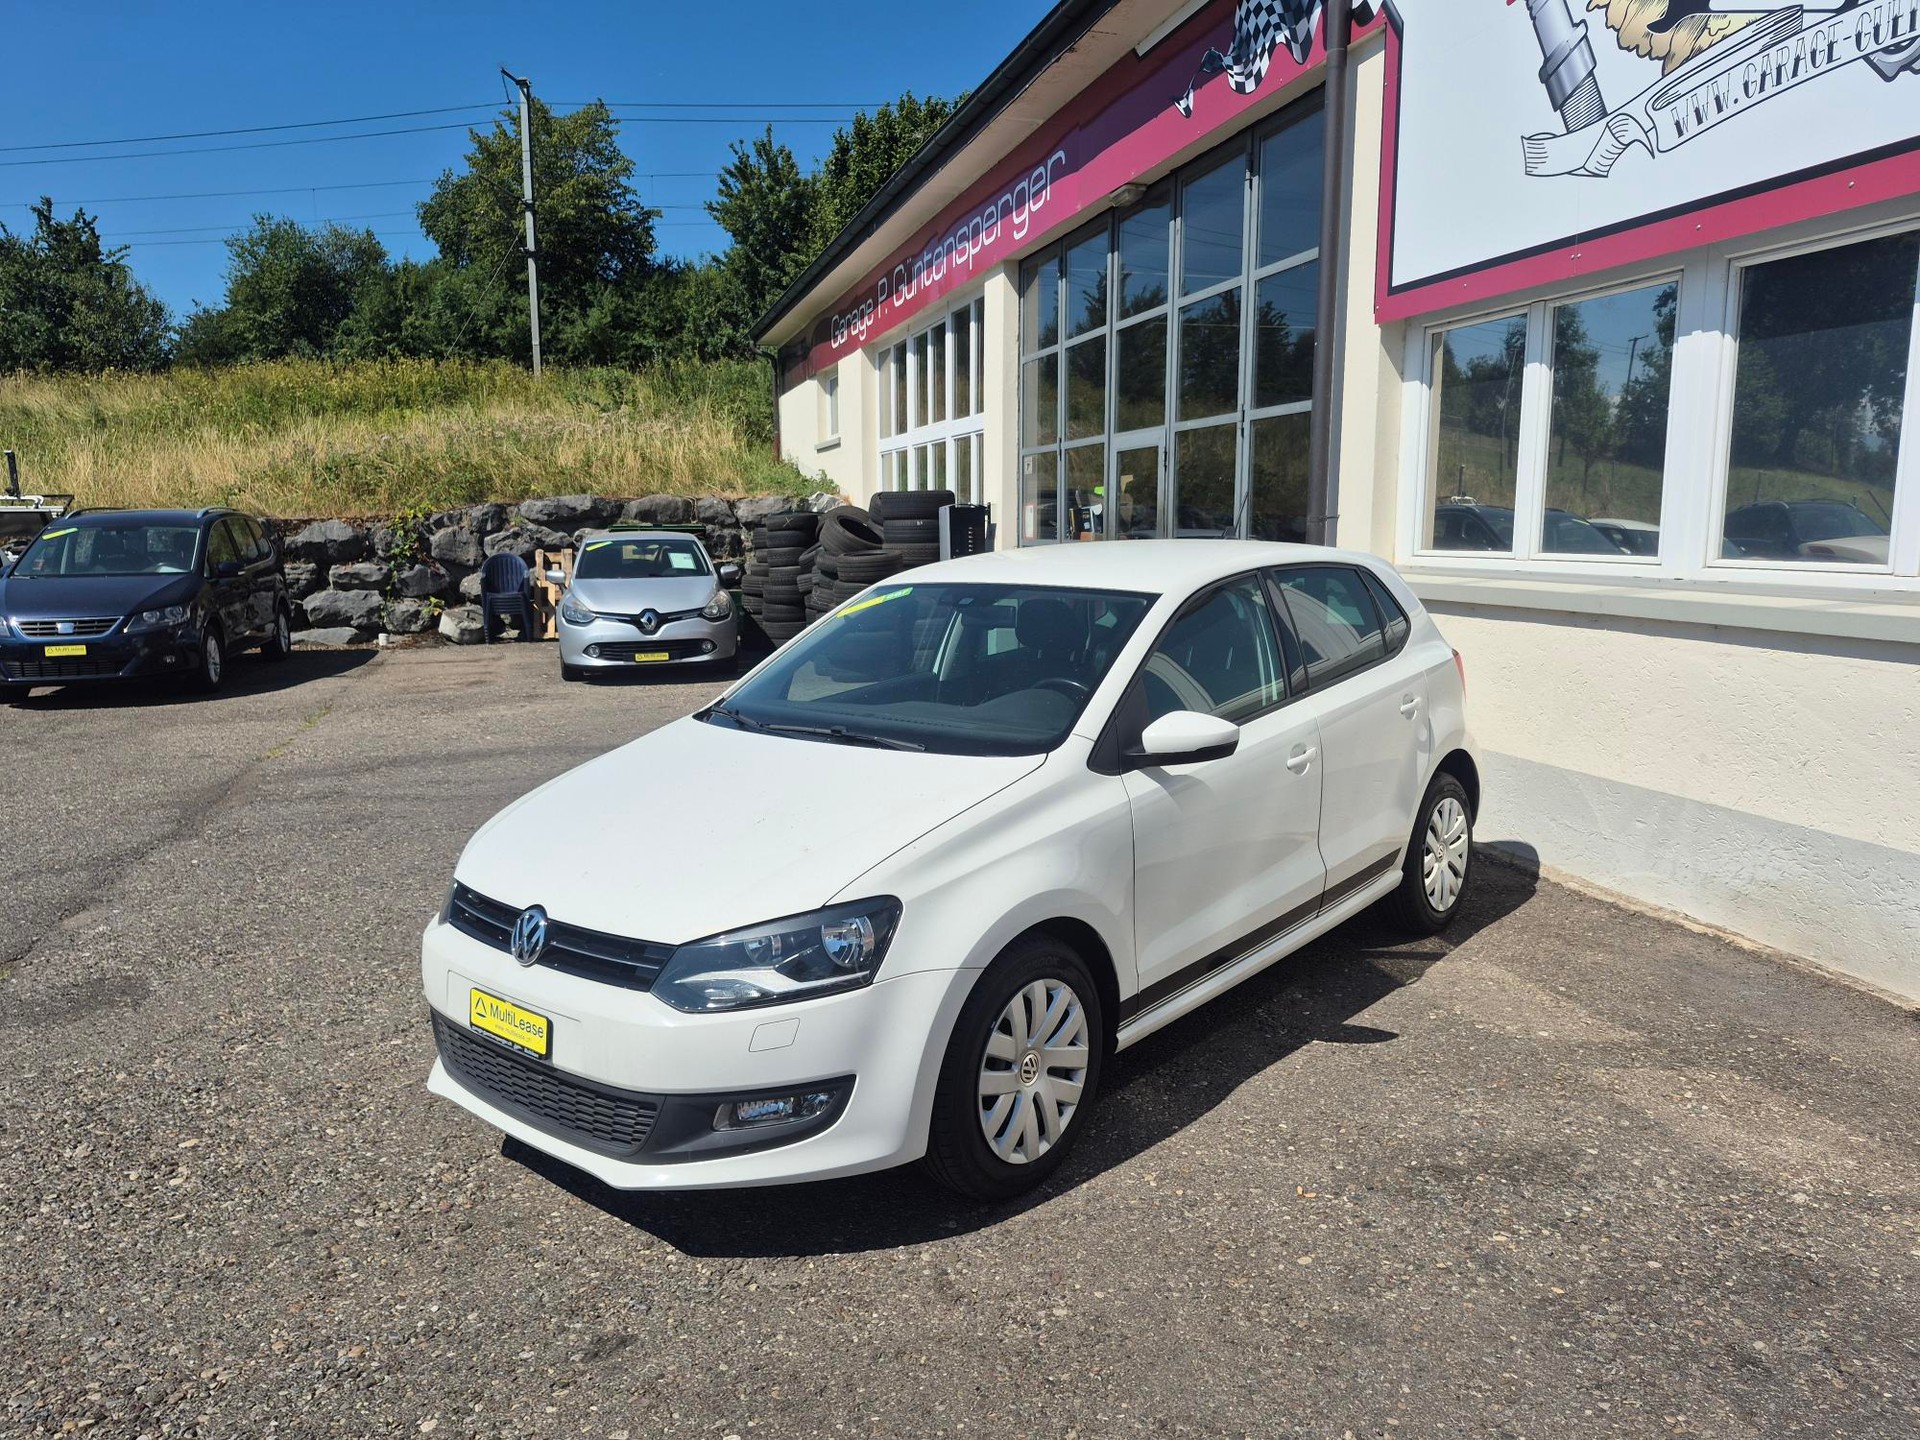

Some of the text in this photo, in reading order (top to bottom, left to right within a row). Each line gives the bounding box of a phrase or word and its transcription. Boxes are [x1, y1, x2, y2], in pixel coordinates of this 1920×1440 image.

[830, 150, 1066, 349] Garage P. Güntensperger
[489, 1002, 545, 1039] MultiLease
